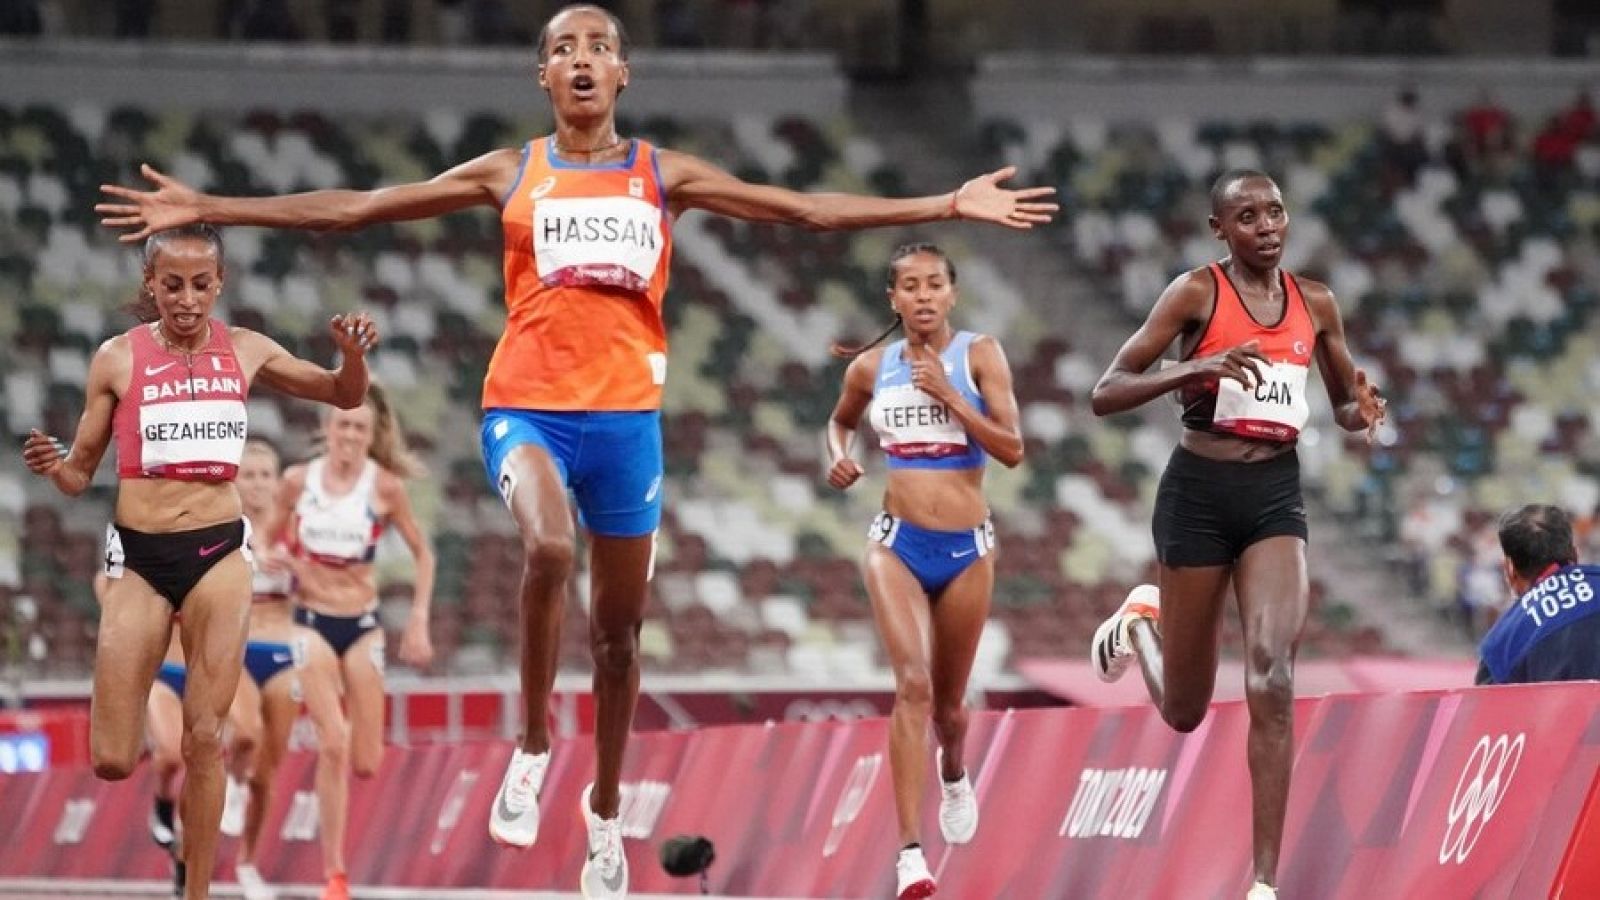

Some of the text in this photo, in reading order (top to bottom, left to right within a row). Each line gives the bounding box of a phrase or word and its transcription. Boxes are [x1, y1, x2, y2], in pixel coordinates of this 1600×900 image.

[543, 216, 656, 250] HASSAN
[143, 378, 241, 401] BAHRAIN
[1255, 380, 1292, 406] CAN
[882, 404, 950, 427] TEFERI
[145, 421, 245, 442] GEZAHEGNE
[1527, 581, 1594, 626] 1058
